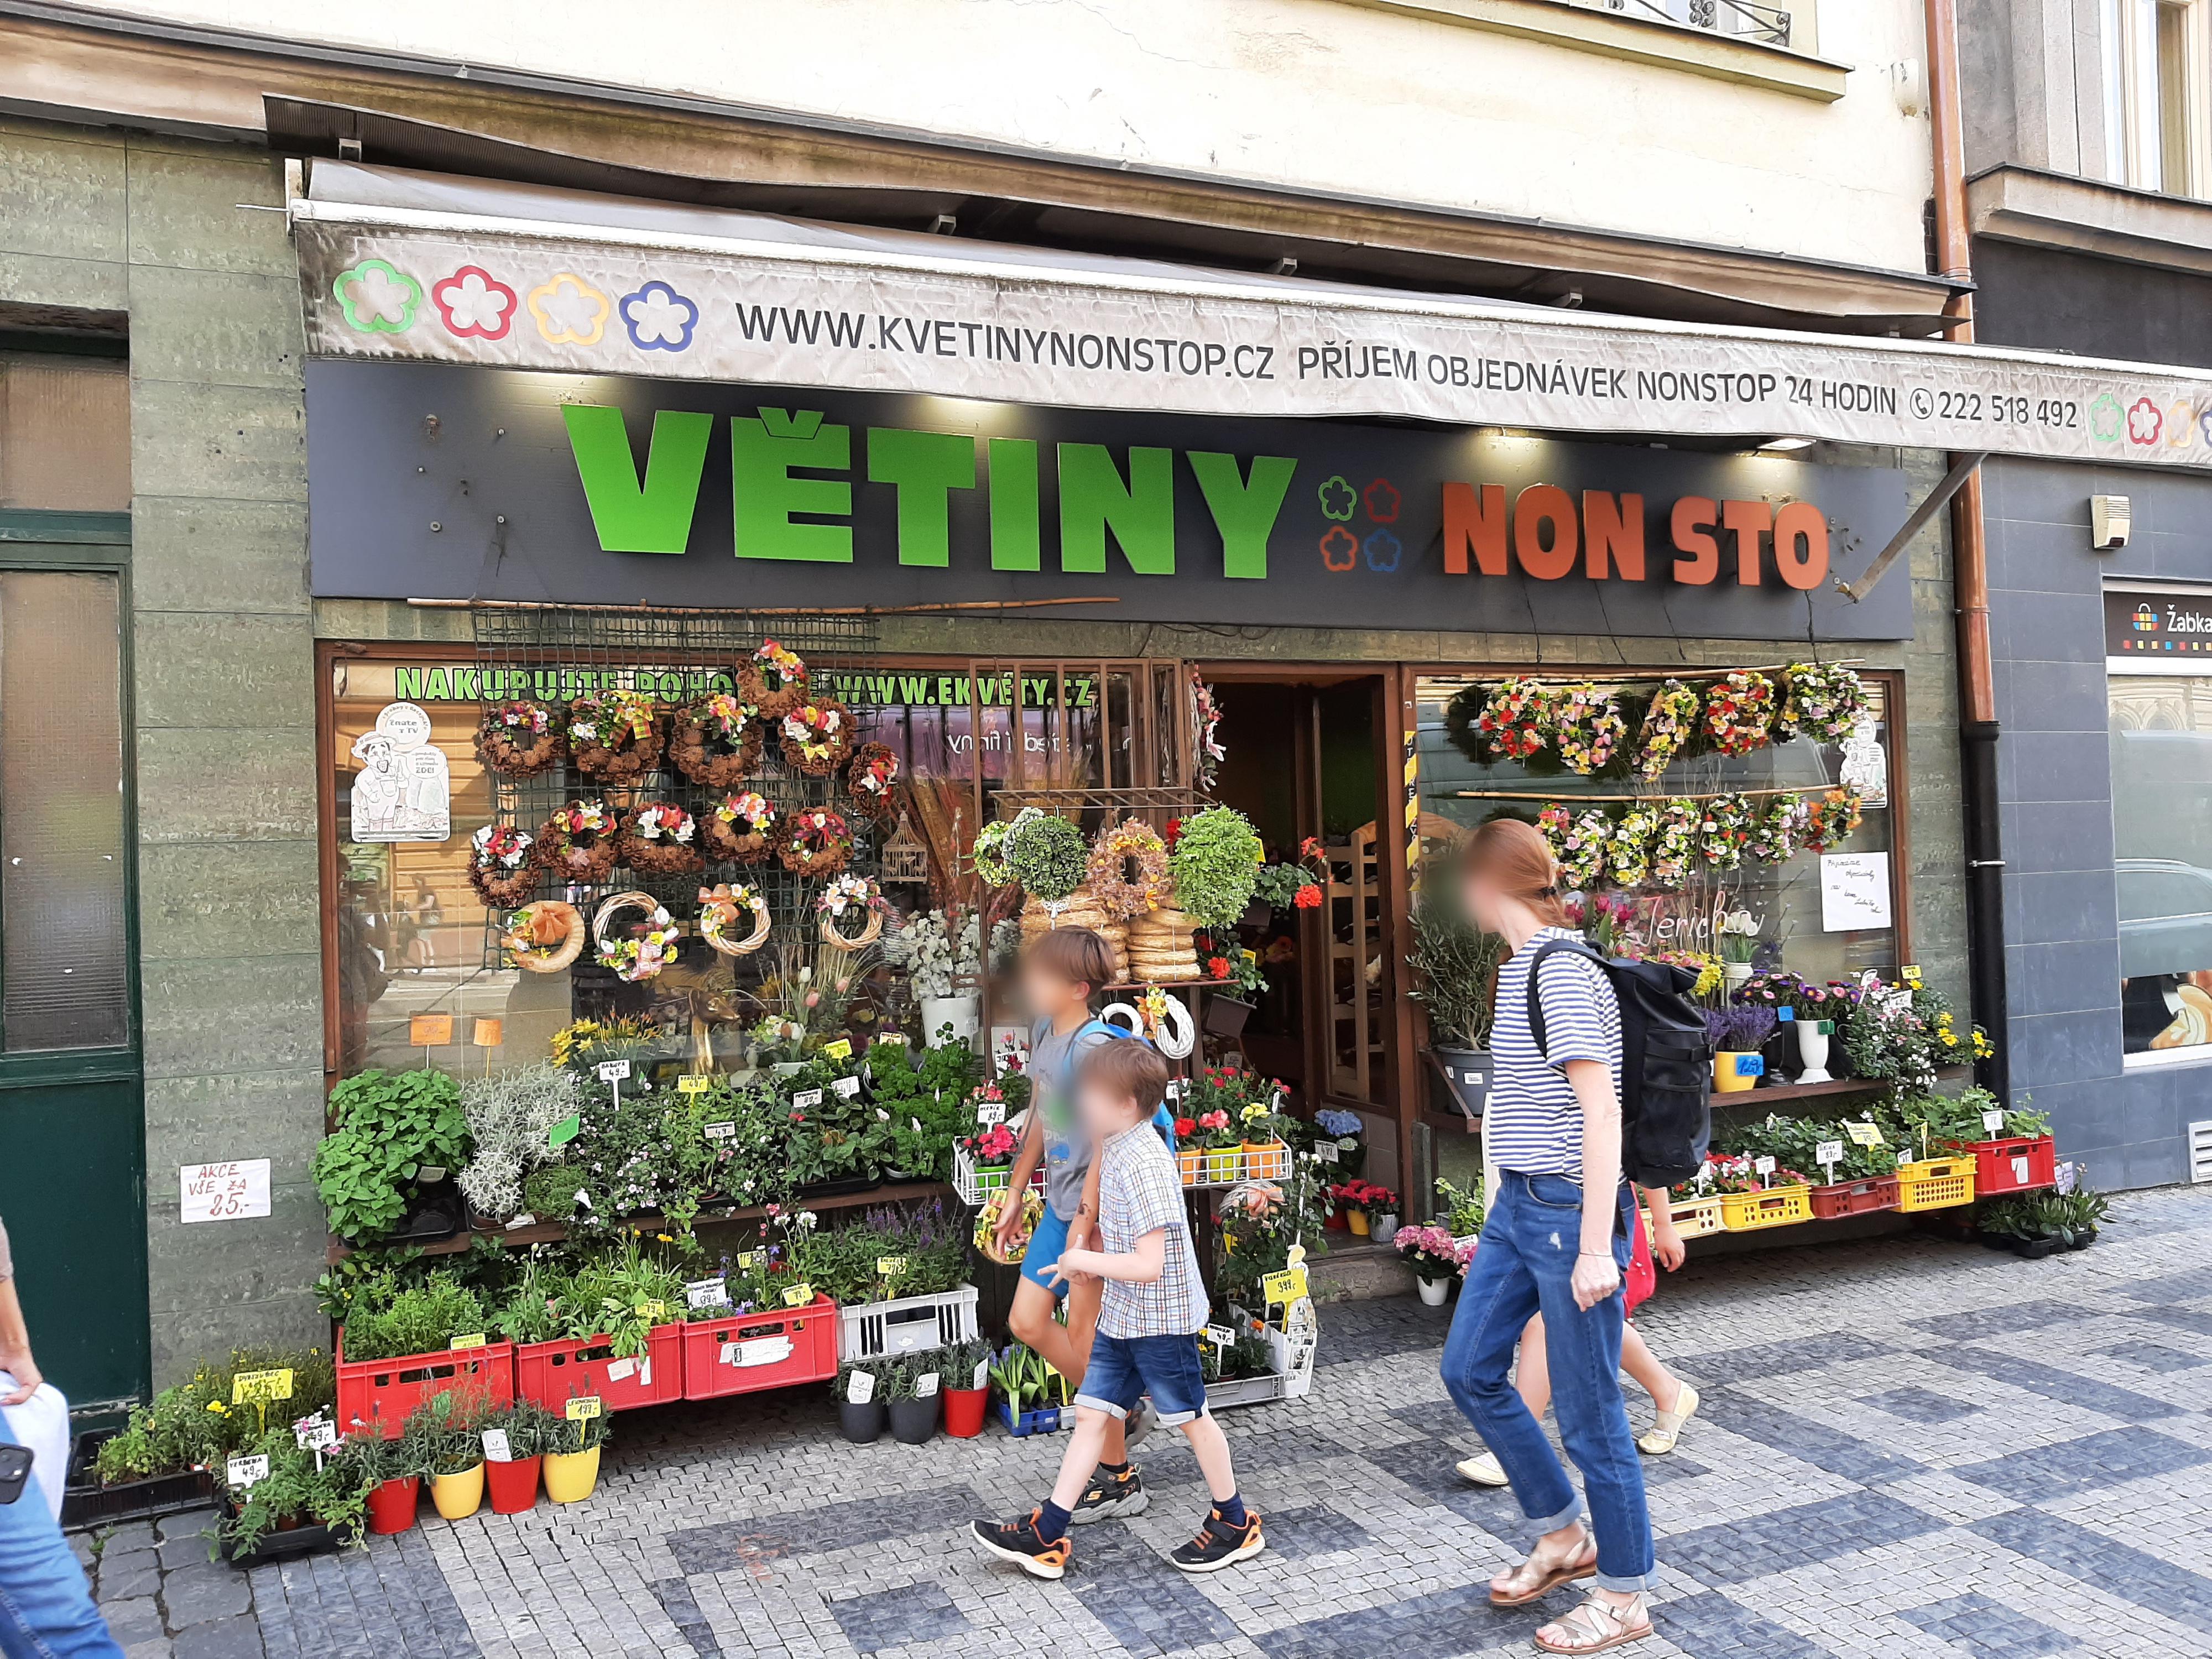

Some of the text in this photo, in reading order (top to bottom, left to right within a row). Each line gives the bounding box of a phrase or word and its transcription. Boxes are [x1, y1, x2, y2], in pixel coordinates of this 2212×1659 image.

[736, 302, 2077, 428] WWW.KVETINYNONSTOP.CZ PŘÍJEM OBJEDNÁVEK NONSTOP 24 HODIN 222 518 492
[561, 404, 1298, 578] VĚTINY
[1442, 482, 1828, 590] NON STO
[2167, 604, 2212, 633] Žabka
[395, 666, 617, 701] NAKUPUJTE
[189, 1180, 216, 1196] VŠE
[198, 1164, 240, 1178] AKCE
